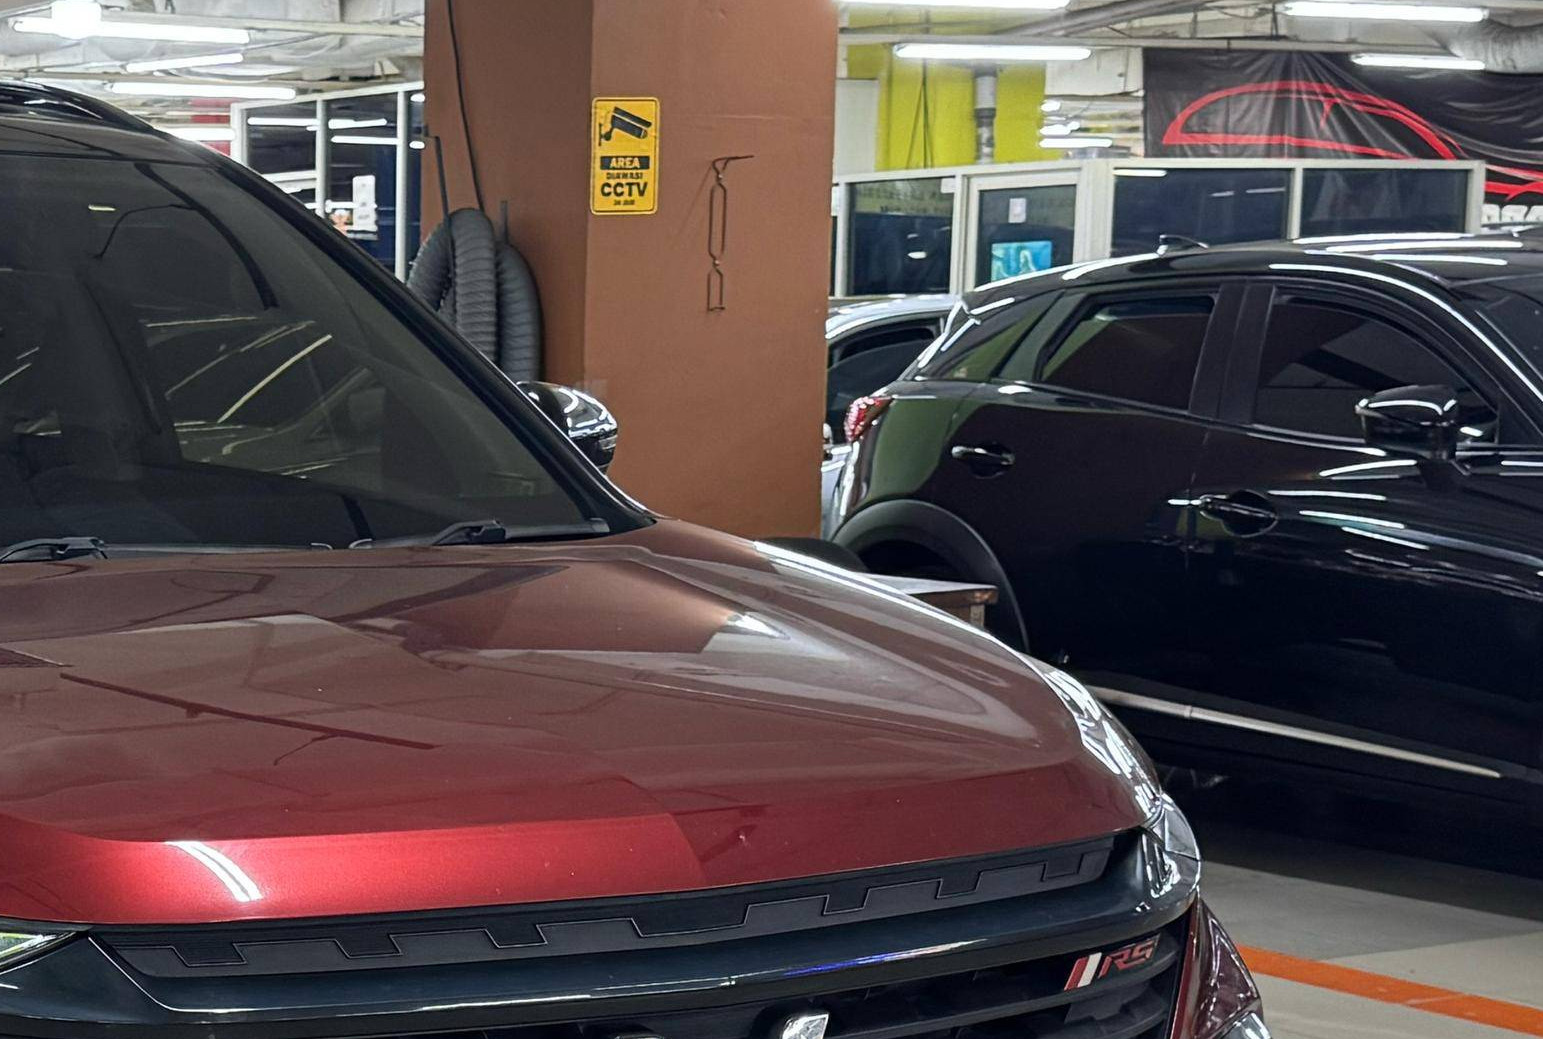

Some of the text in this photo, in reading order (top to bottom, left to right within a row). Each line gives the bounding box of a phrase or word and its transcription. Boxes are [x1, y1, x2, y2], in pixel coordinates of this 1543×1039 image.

[609, 157, 640, 168] AREA
[600, 182, 648, 197] CCTV
[1098, 933, 1160, 979] RS
